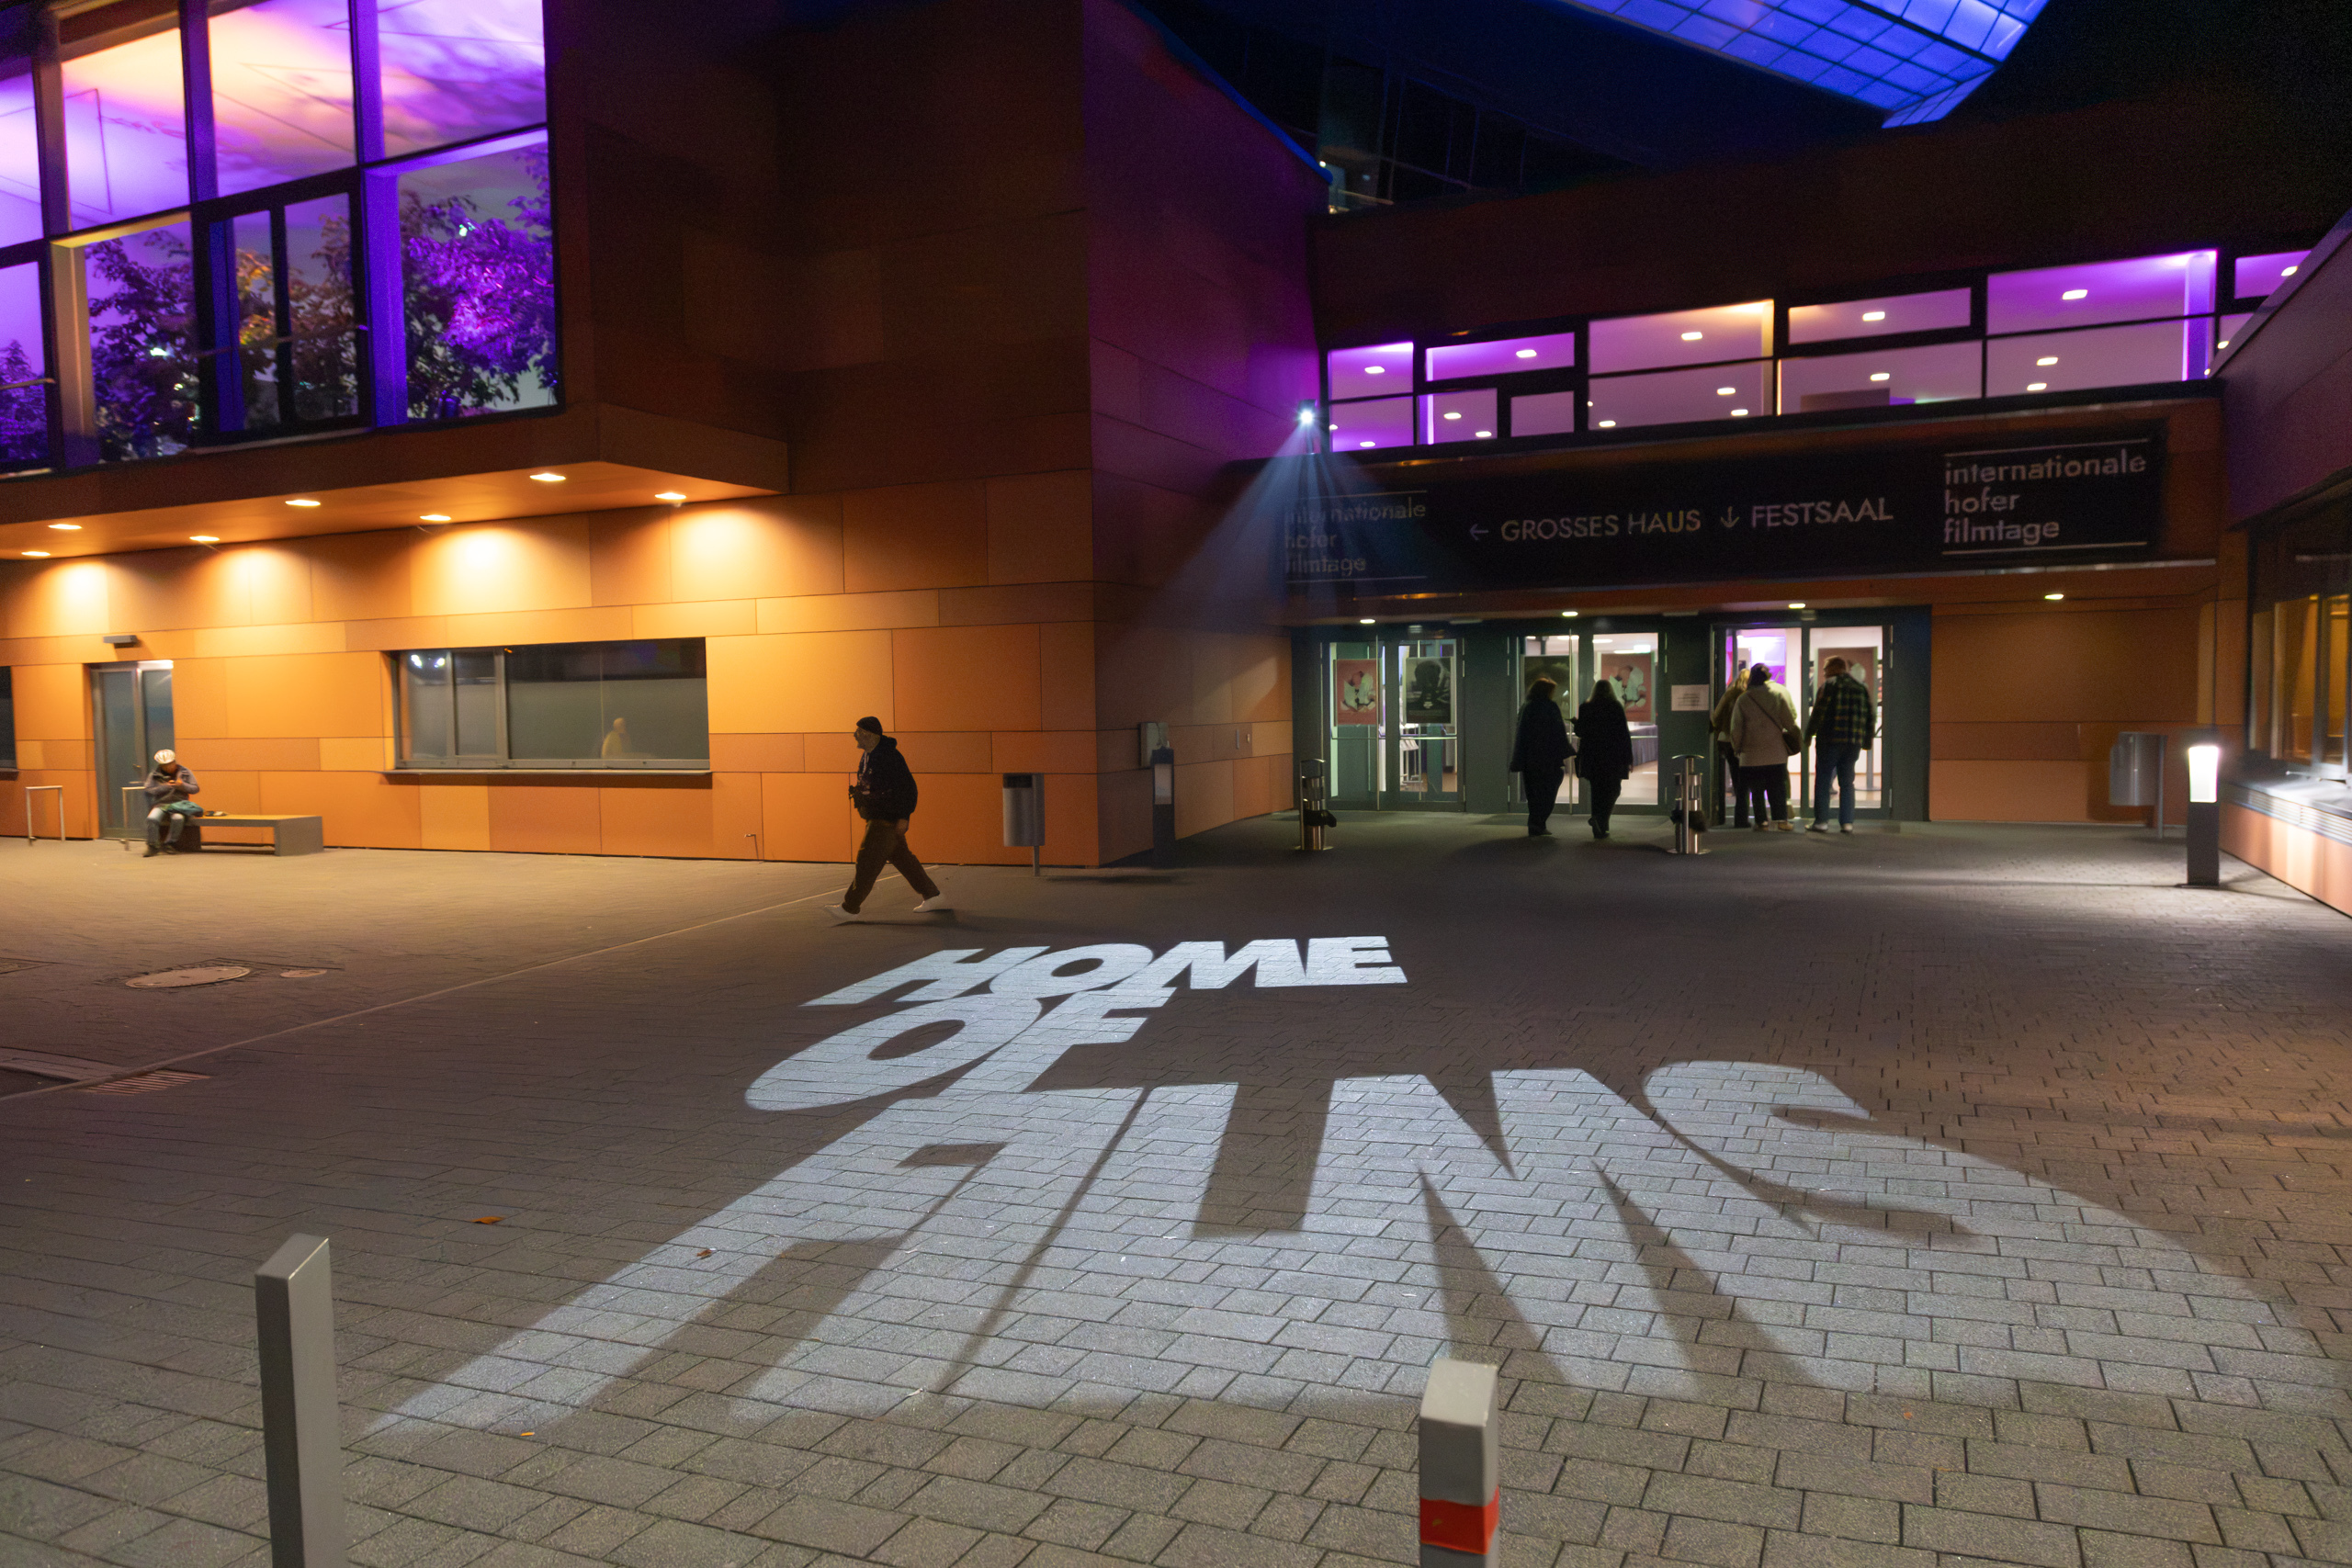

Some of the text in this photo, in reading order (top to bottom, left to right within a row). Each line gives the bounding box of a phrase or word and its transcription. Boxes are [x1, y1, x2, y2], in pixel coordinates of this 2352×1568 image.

[1945, 448, 2146, 485] internationale
[1751, 497, 1894, 529] FESTSAAL
[1945, 487, 2020, 514] hofer
[1501, 510, 1701, 542] GROSSES HAUS
[1944, 517, 2060, 546] filmtage
[799, 935, 1408, 1007] HOME
[745, 987, 1176, 1112] OF
[364, 1060, 2349, 1437] FILMS
